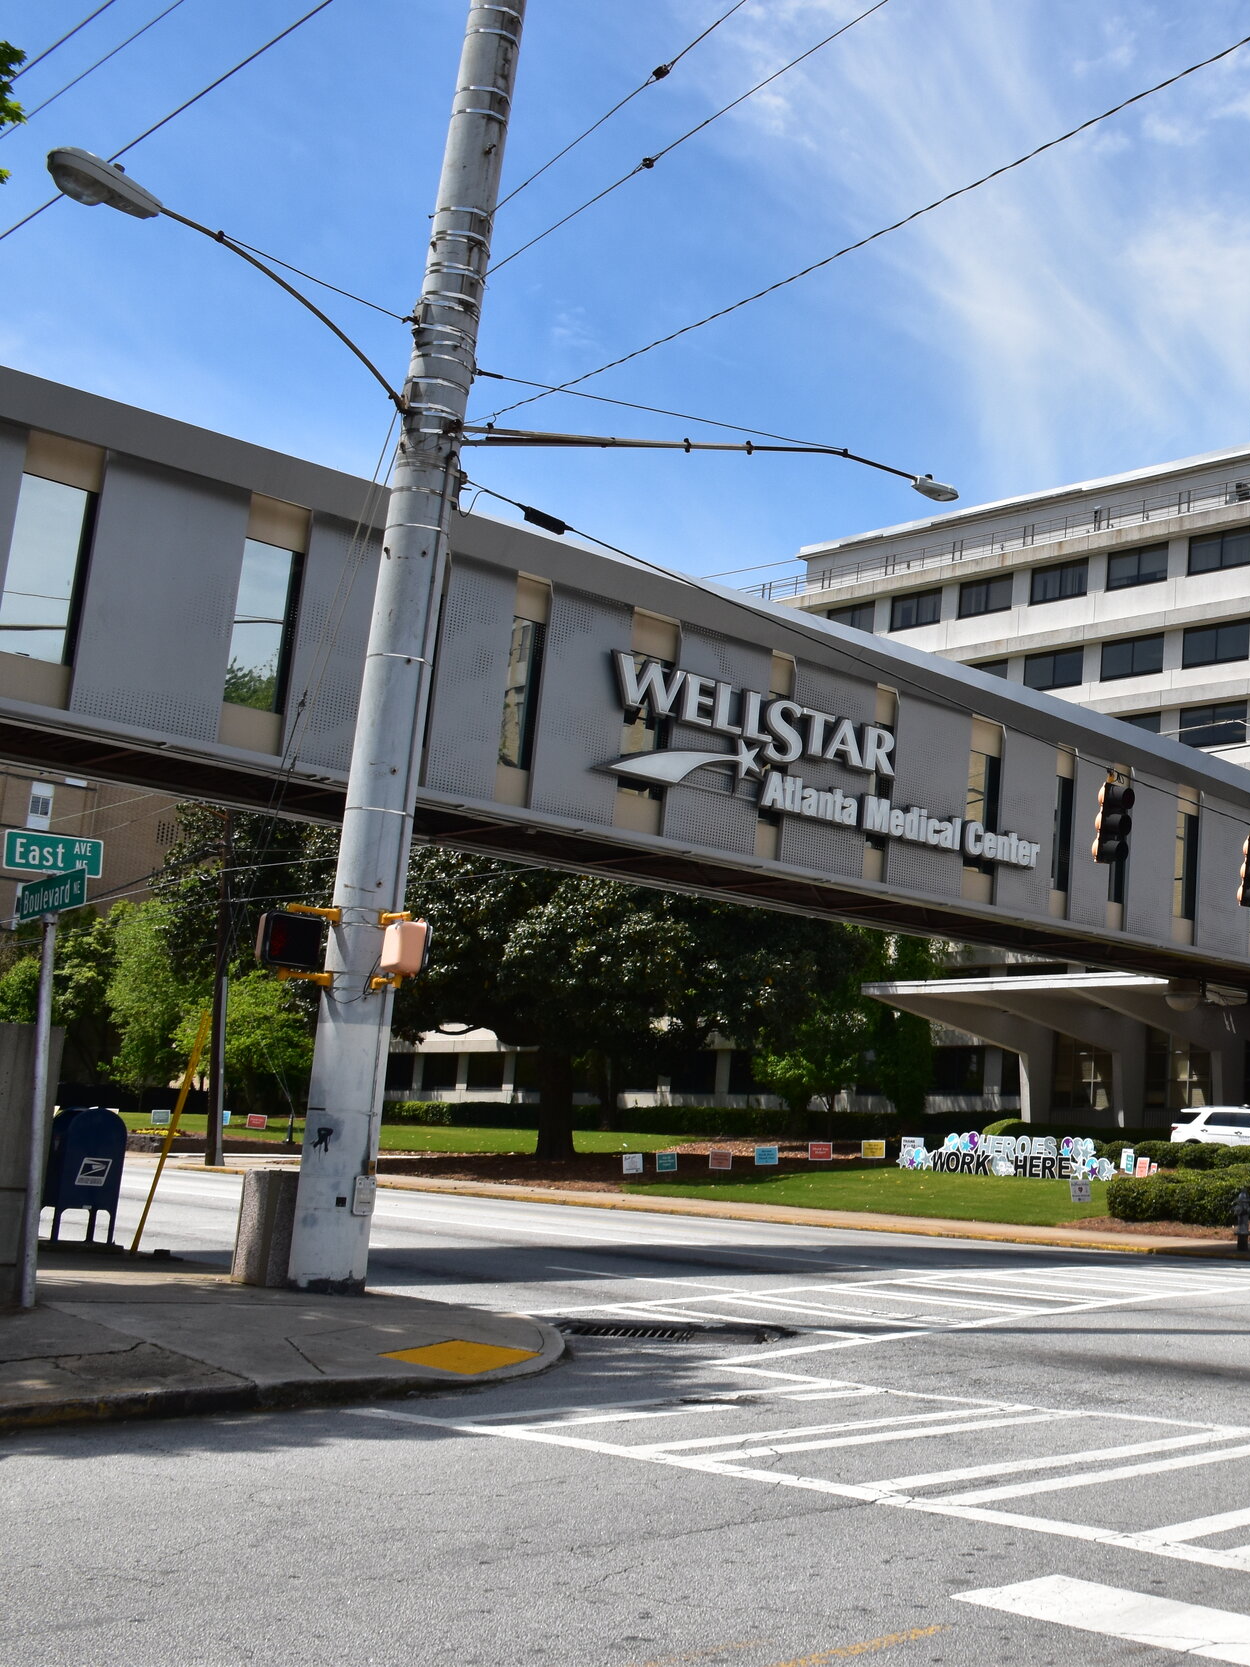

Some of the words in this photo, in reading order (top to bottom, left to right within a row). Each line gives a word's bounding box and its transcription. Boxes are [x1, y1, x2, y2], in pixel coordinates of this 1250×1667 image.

[612, 650, 896, 779] WELLSTAR
[760, 771, 858, 826] Atlanta
[864, 795, 961, 850] Medical
[965, 820, 1041, 868] Center
[15, 838, 65, 868] East
[74, 842, 92, 856] AVE
[23, 879, 71, 915] Boulevard
[73, 880, 81, 894] NE
[978, 1135, 1058, 1160] HEROES
[932, 1150, 991, 1176] WORK
[1014, 1155, 1071, 1180] HERE
